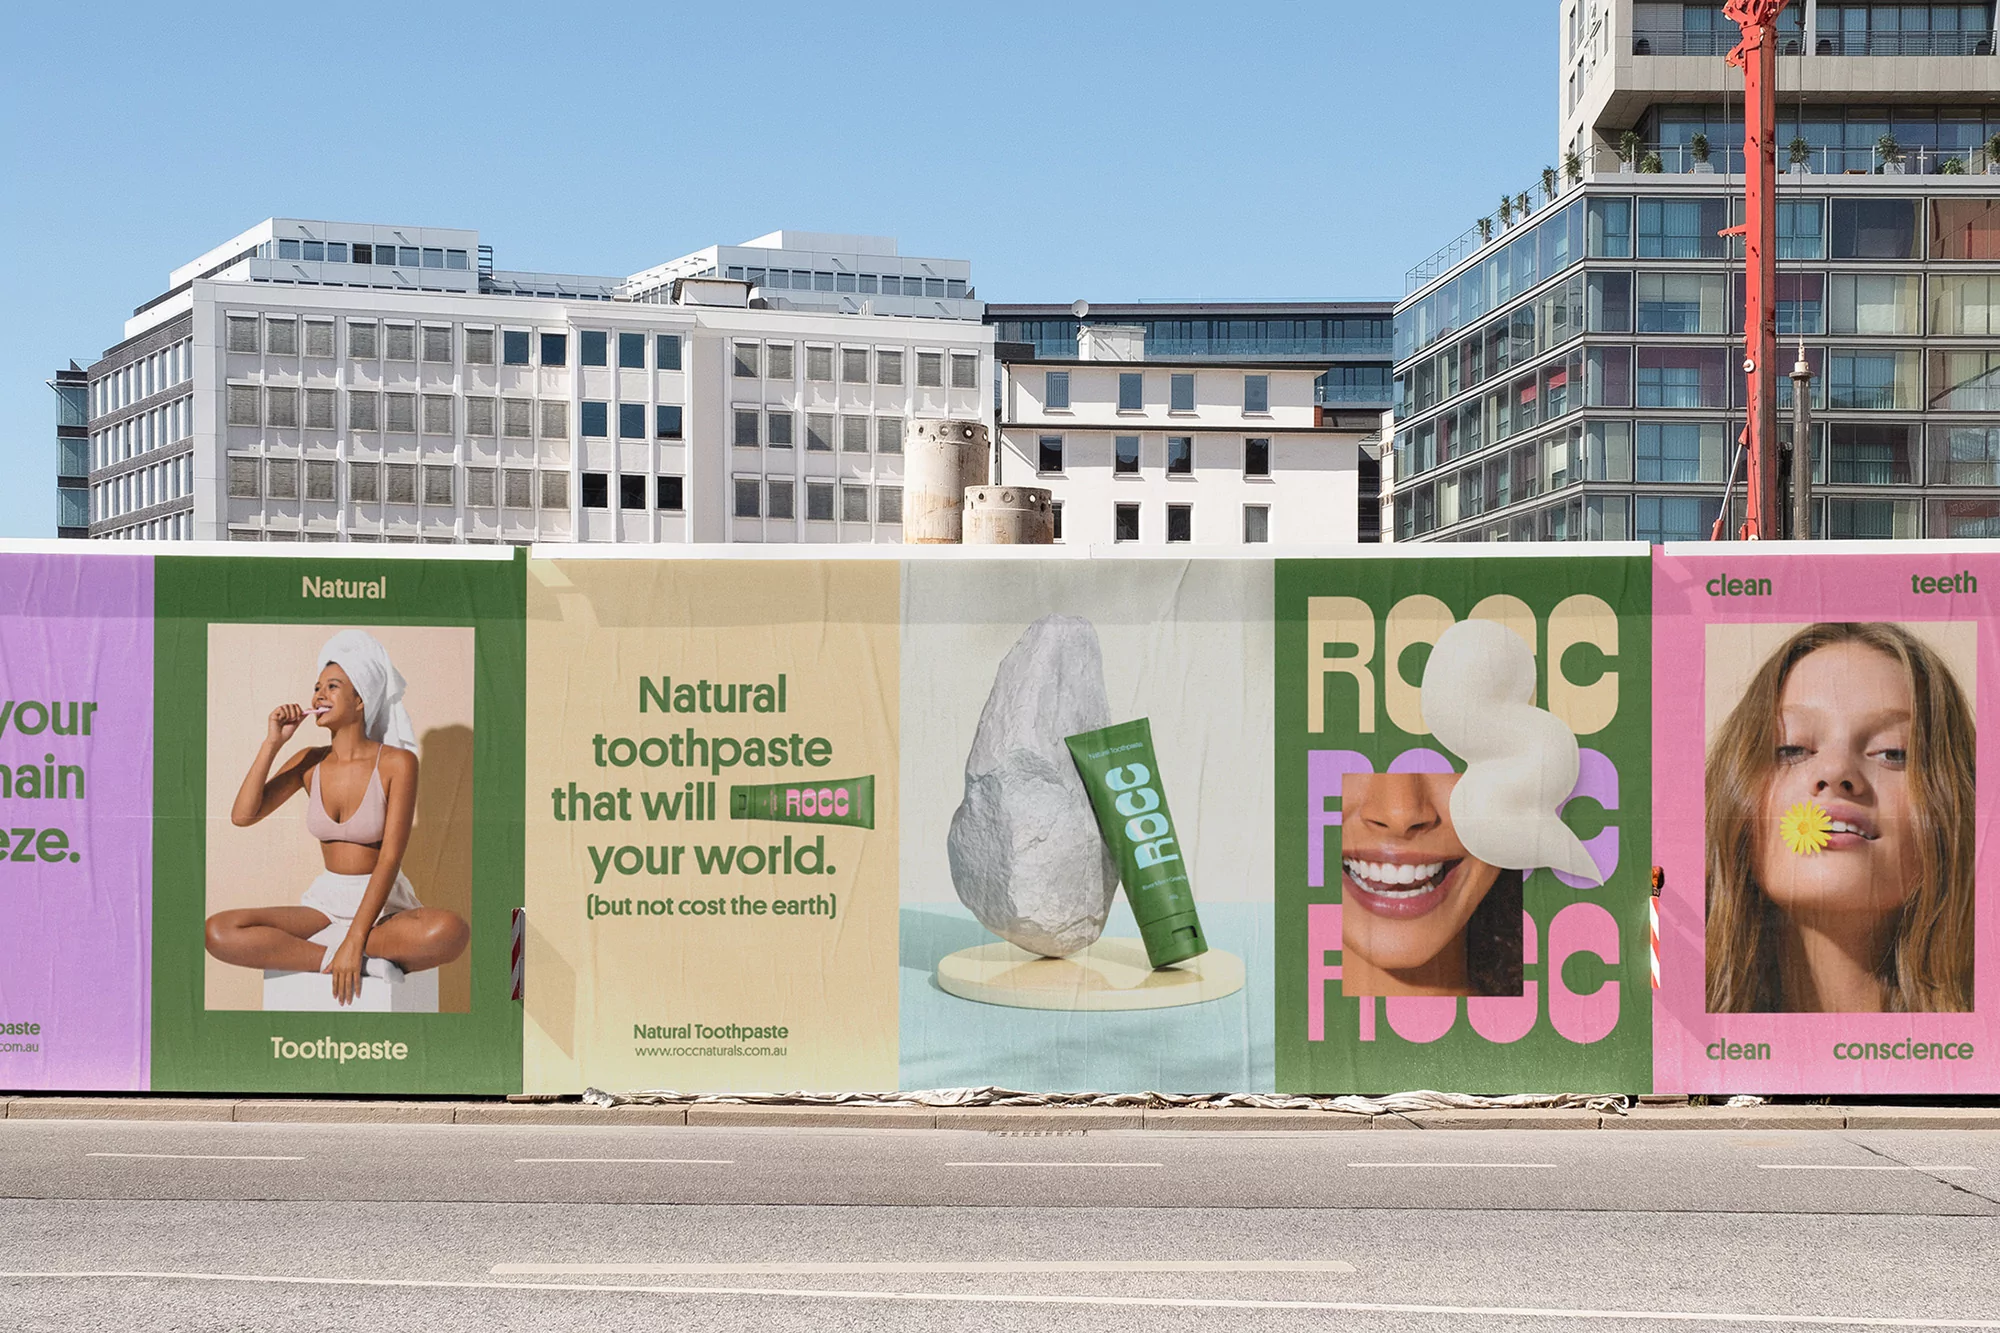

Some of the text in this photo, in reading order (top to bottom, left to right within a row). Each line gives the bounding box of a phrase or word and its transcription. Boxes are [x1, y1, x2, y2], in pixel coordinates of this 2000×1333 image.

[302, 575, 386, 599] Natural
[1706, 570, 1978, 597] clean teeth
[639, 673, 788, 714] Natural
[592, 727, 833, 776] toothpaste
[551, 781, 632, 822] that
[640, 781, 716, 822] will
[785, 787, 849, 817] ROCC
[1105, 762, 1180, 870] ROCC
[1308, 748, 1619, 889] RC
[587, 835, 837, 885] your world.
[587, 892, 837, 921] (but not cost the earth)
[633, 1023, 789, 1044] Natural Toothpaste
[270, 1036, 409, 1066] Toothpaste
[634, 1044, 788, 1058] www.roccnaturals.com.au
[1706, 1037, 1975, 1061] clean conscience
